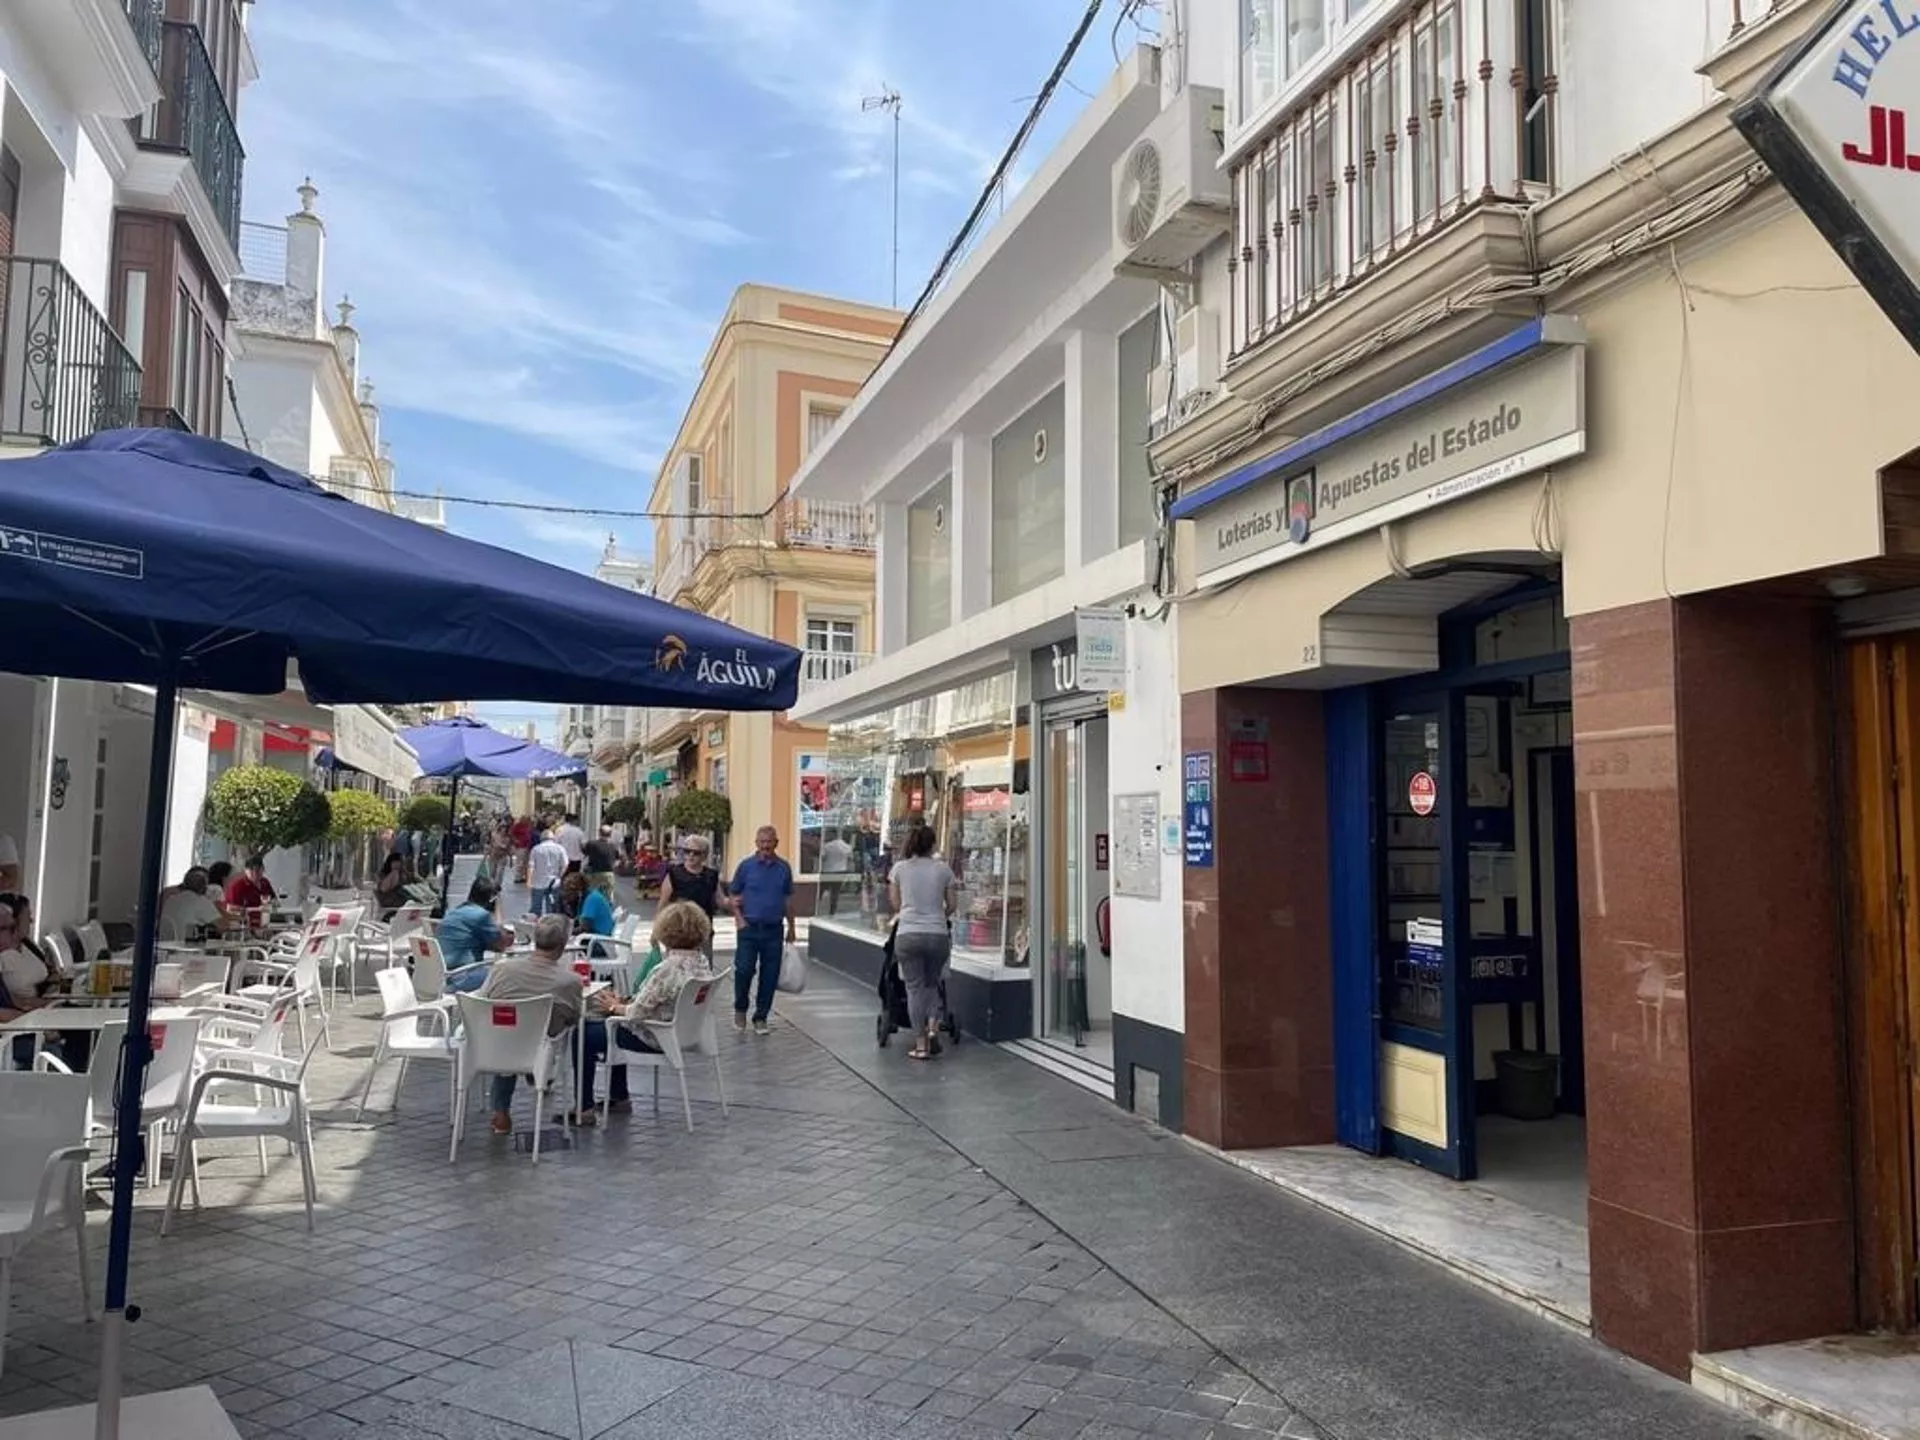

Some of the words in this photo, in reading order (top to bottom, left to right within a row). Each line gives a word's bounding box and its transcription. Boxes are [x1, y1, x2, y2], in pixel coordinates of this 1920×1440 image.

[1218, 511, 1272, 551] Loterías
[1275, 506, 1285, 533] y
[1318, 457, 1400, 510] Apuestas
[1406, 434, 1436, 472] del
[1442, 404, 1522, 457] Estado
[735, 648, 748, 665] EL
[1051, 644, 1076, 691] tu
